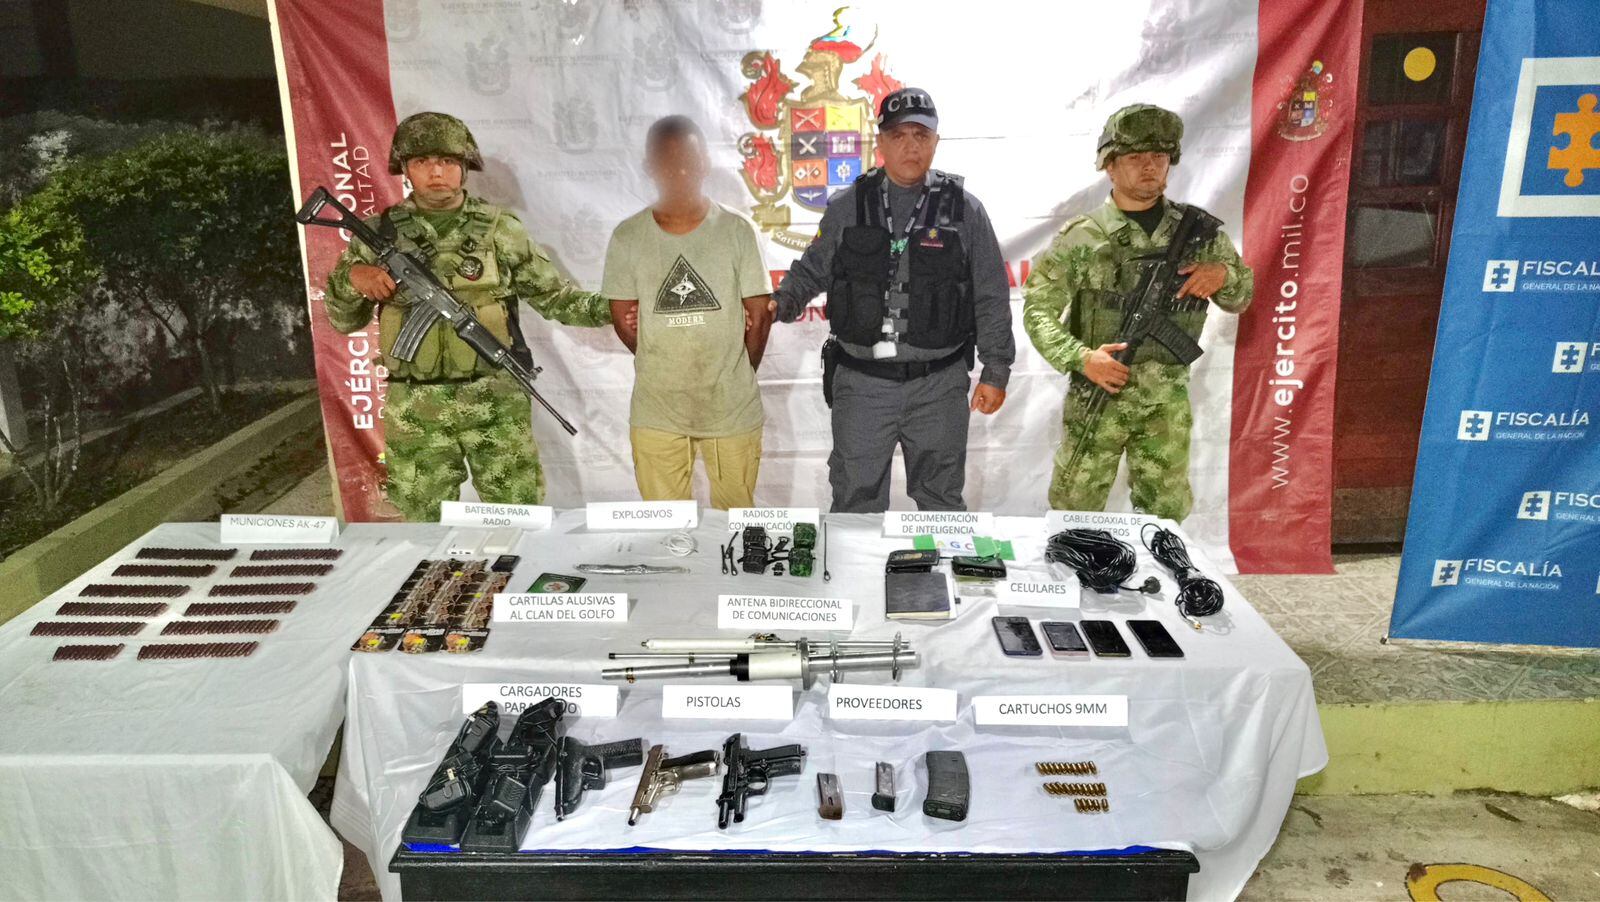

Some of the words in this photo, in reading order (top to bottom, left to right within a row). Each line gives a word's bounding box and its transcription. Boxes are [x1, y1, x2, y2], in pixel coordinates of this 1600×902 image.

[353, 146, 375, 217] ALTAD
[1522, 282, 1561, 291] GENERAL
[1577, 283, 1588, 291] LA
[1269, 173, 1309, 490] www.ejercito.mil.co
[345, 331, 374, 430] EJÉRCI
[1496, 409, 1590, 426] FISCALÍA
[1496, 432, 1532, 440] GENERAL
[465, 505, 506, 516] BATERÍAS
[507, 508, 530, 517] PARA
[612, 509, 673, 520] EXPLOSIVOS
[743, 510, 775, 519] RADIOS
[777, 510, 788, 518] DE
[230, 517, 295, 528] MUNICIONES
[296, 520, 326, 529] AK-47
[482, 518, 511, 527] RADIO
[900, 513, 978, 523] DOCUMENTACIÓN
[1063, 514, 1090, 523] CABLE
[1091, 515, 1129, 524] COAXIAL
[1131, 517, 1142, 525] DE
[902, 525, 914, 533] DE
[916, 525, 975, 535] INTELIGENCIA
[1464, 558, 1563, 578] FISCALÍA
[1010, 582, 1066, 595] CELULARES
[509, 596, 564, 606] CARTILLAS
[566, 595, 616, 606] ALUSIVAS
[727, 598, 767, 608] ANTENA
[769, 598, 842, 609] BIDIRECCIONAL
[510, 610, 523, 620] AL
[525, 610, 554, 620] CLAN
[557, 609, 575, 620] DEL
[579, 609, 616, 620] GOLFO
[732, 610, 745, 620] DE
[748, 611, 837, 622] COMUNICACIONES
[500, 685, 582, 698] CARGADORES
[686, 696, 741, 708] PISTOLAS
[836, 697, 923, 711] PROVEEDORES
[999, 703, 1072, 715] CARTUCHOS
[1075, 703, 1108, 715] 9MM
